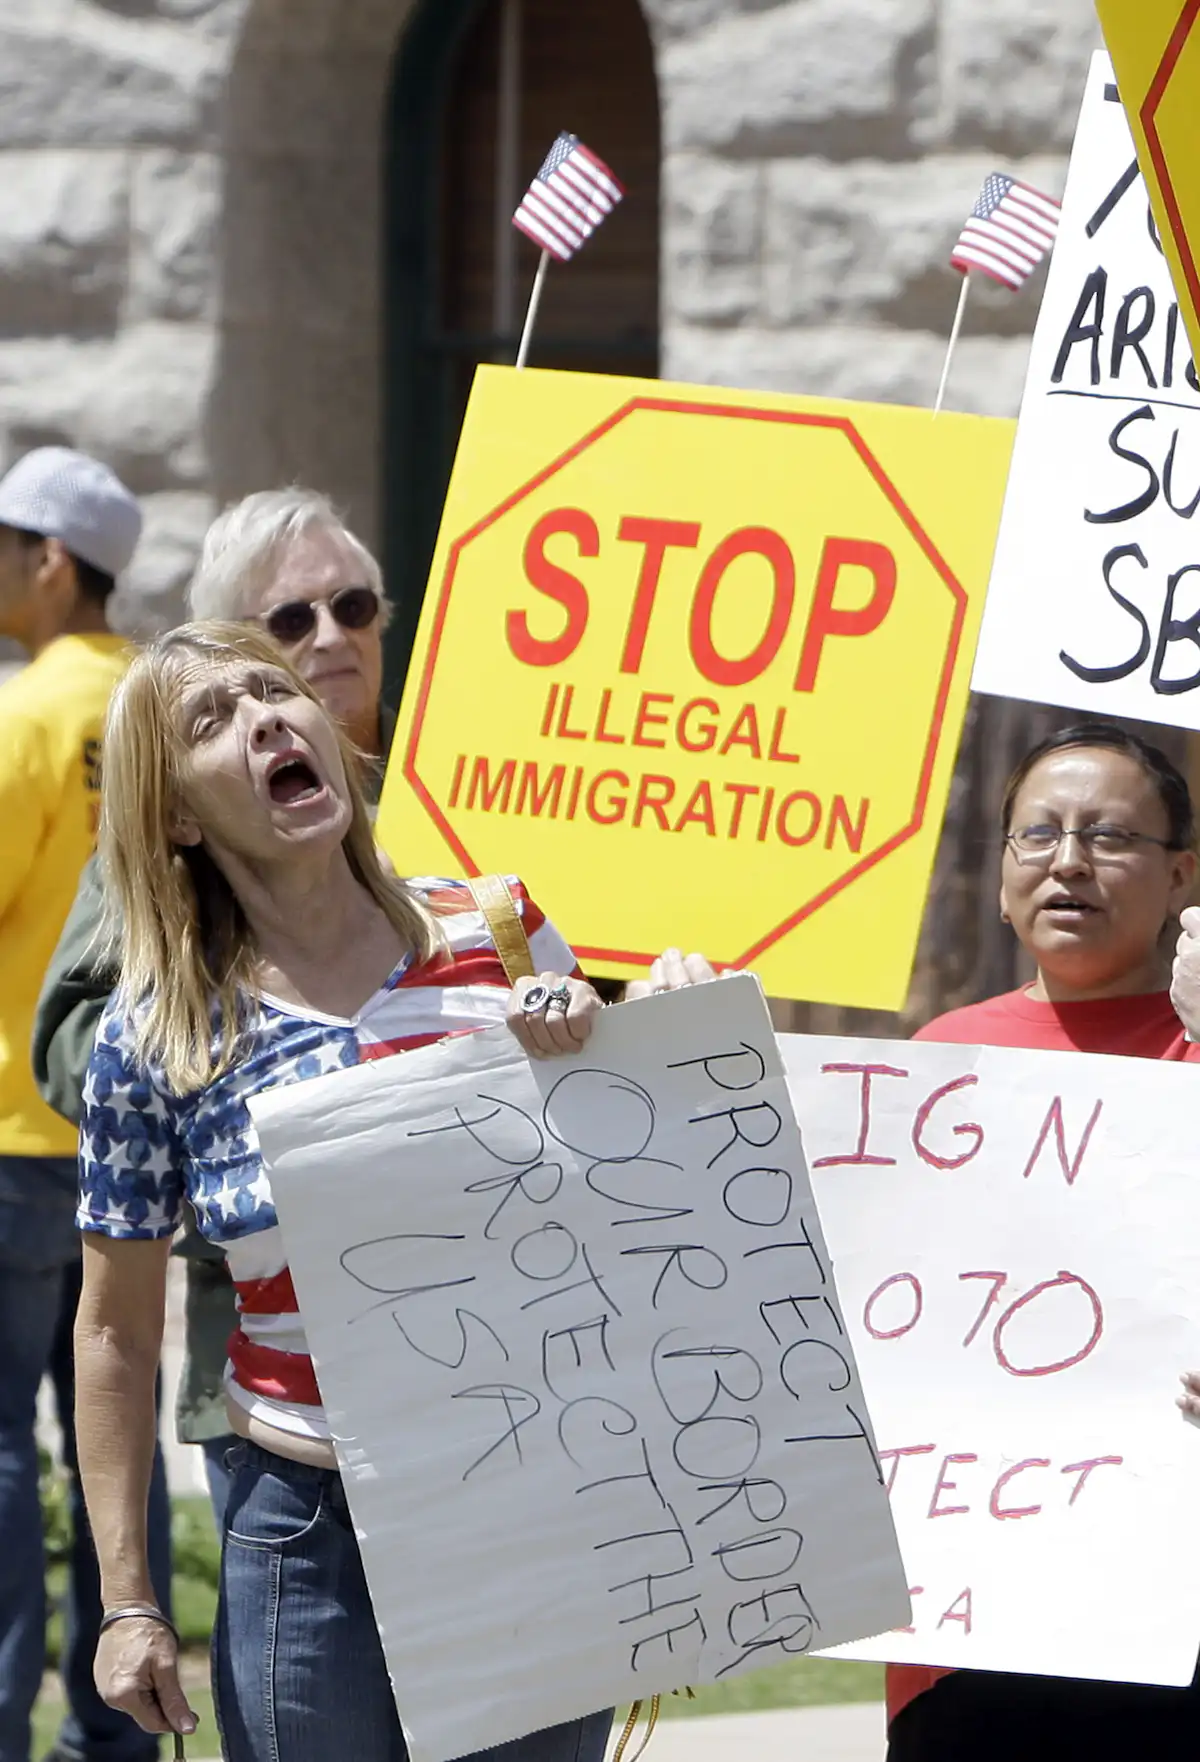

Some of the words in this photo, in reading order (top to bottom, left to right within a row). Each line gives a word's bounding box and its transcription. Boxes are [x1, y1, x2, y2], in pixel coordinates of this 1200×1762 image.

[1050, 265, 1200, 392] ARI
[504, 506, 897, 693] STOP
[1059, 543, 1200, 695] SB
[448, 755, 870, 854] IMMIGRATION
[540, 683, 801, 764] ILLEGAL
[340, 1233, 541, 1481] USA
[666, 1042, 885, 1485] PROTECT
[407, 1094, 666, 1508] PROTECT
[594, 1502, 707, 1672] THE
[543, 1068, 728, 1309] OUR
[651, 1327, 822, 1678] BORDER
